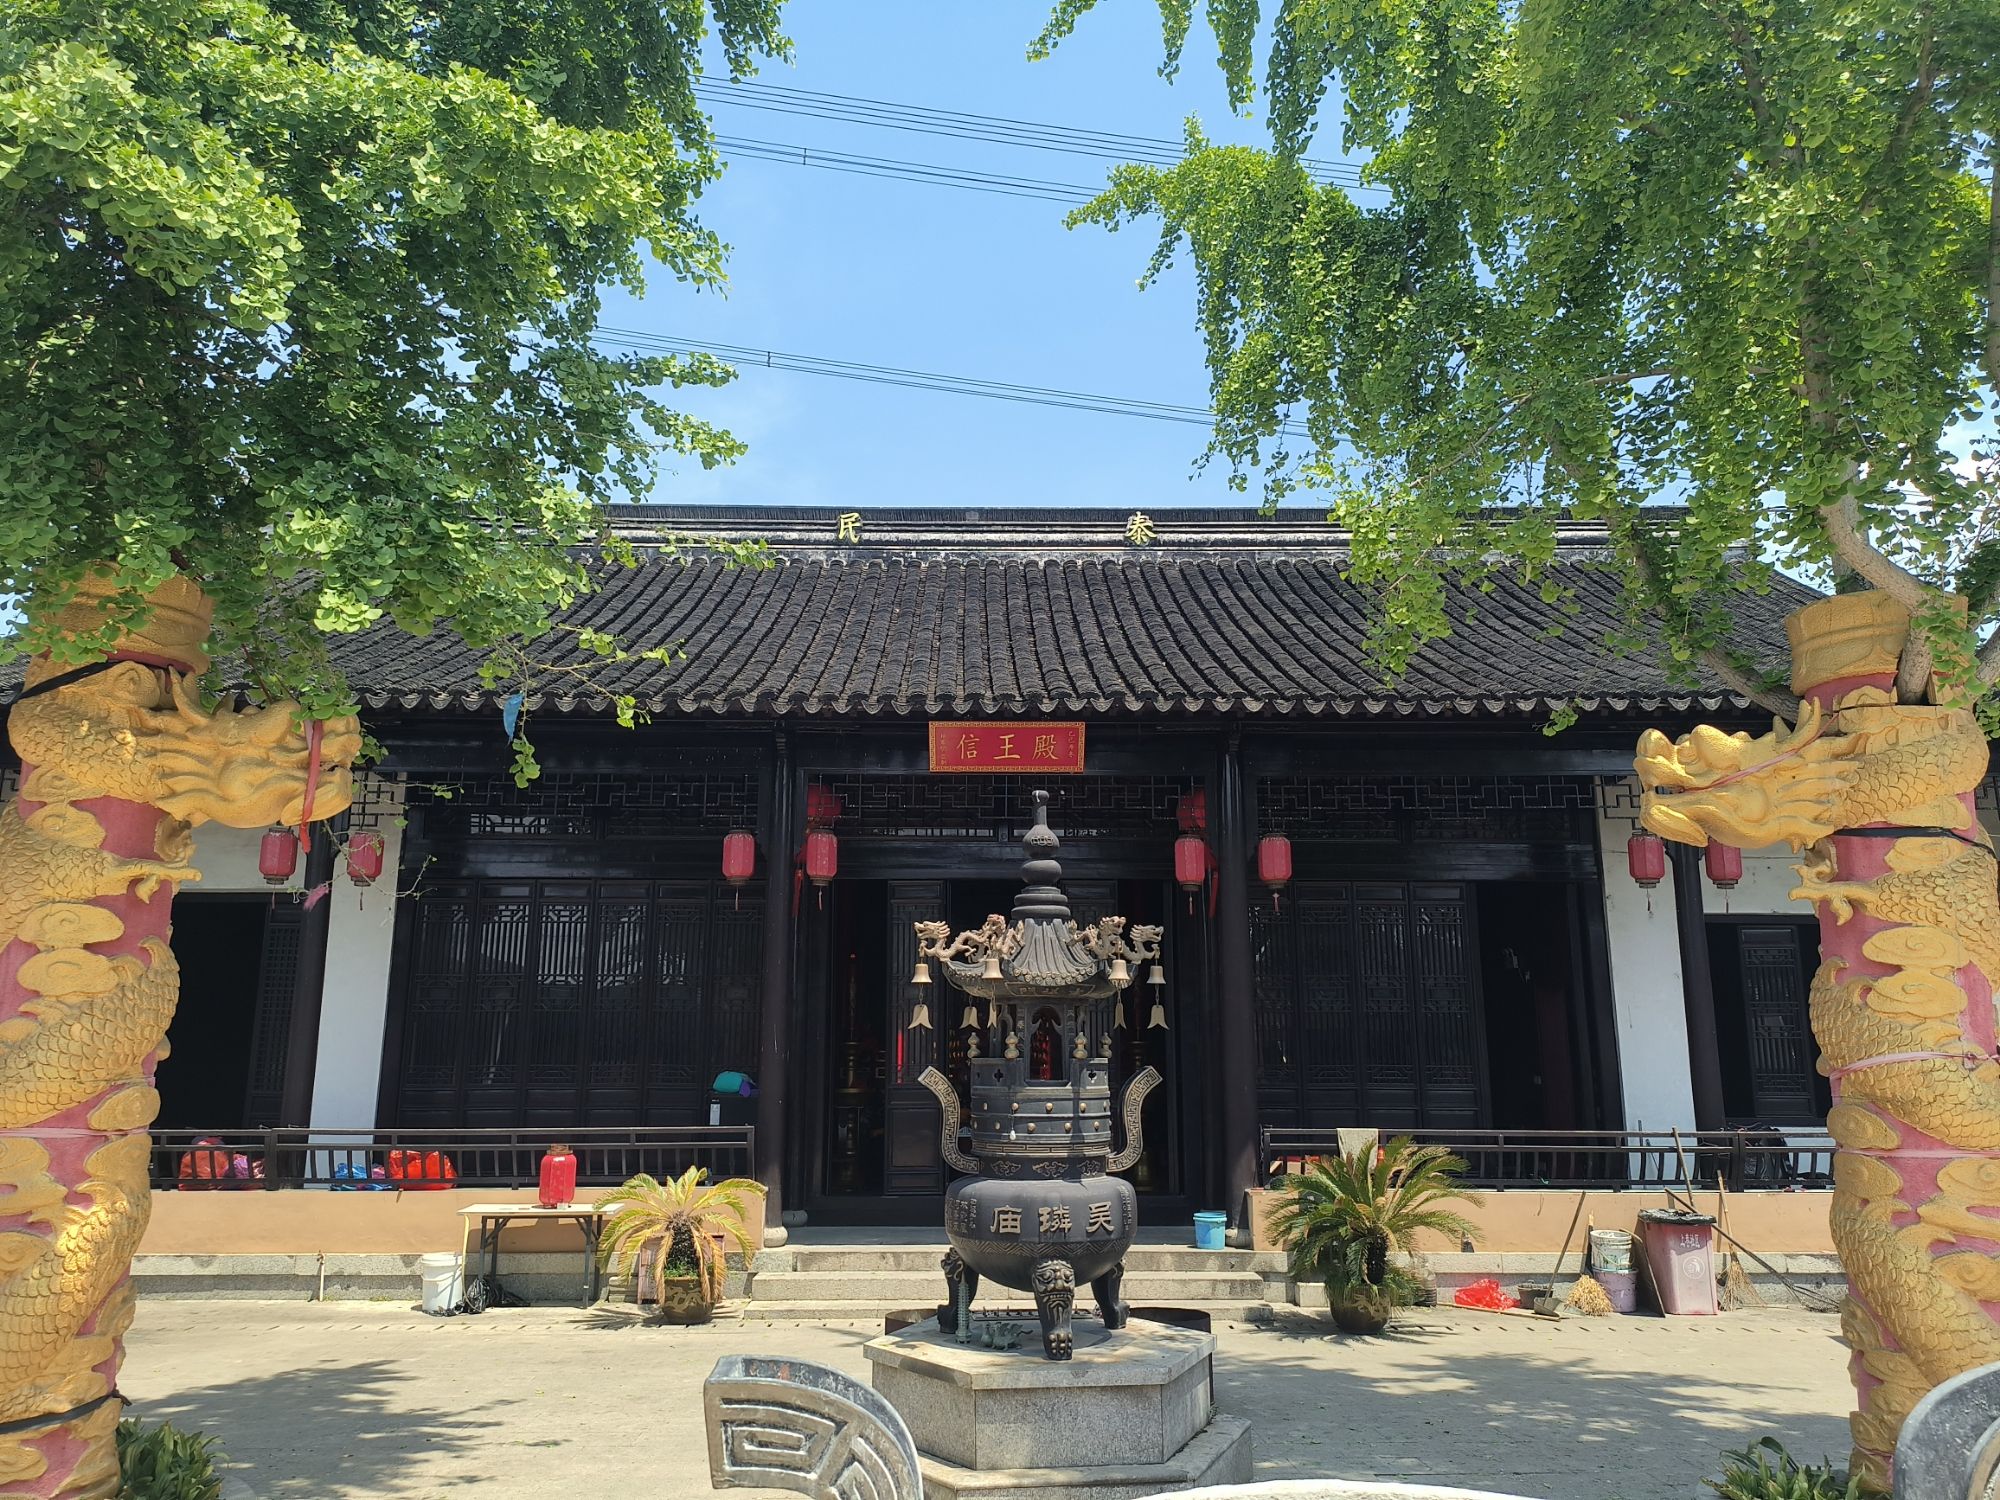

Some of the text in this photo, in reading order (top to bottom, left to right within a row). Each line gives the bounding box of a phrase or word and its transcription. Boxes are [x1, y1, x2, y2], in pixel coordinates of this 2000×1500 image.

[838, 512, 861, 543] 民
[1125, 511, 1158, 545] 泰
[956, 733, 1059, 760] 信王殿
